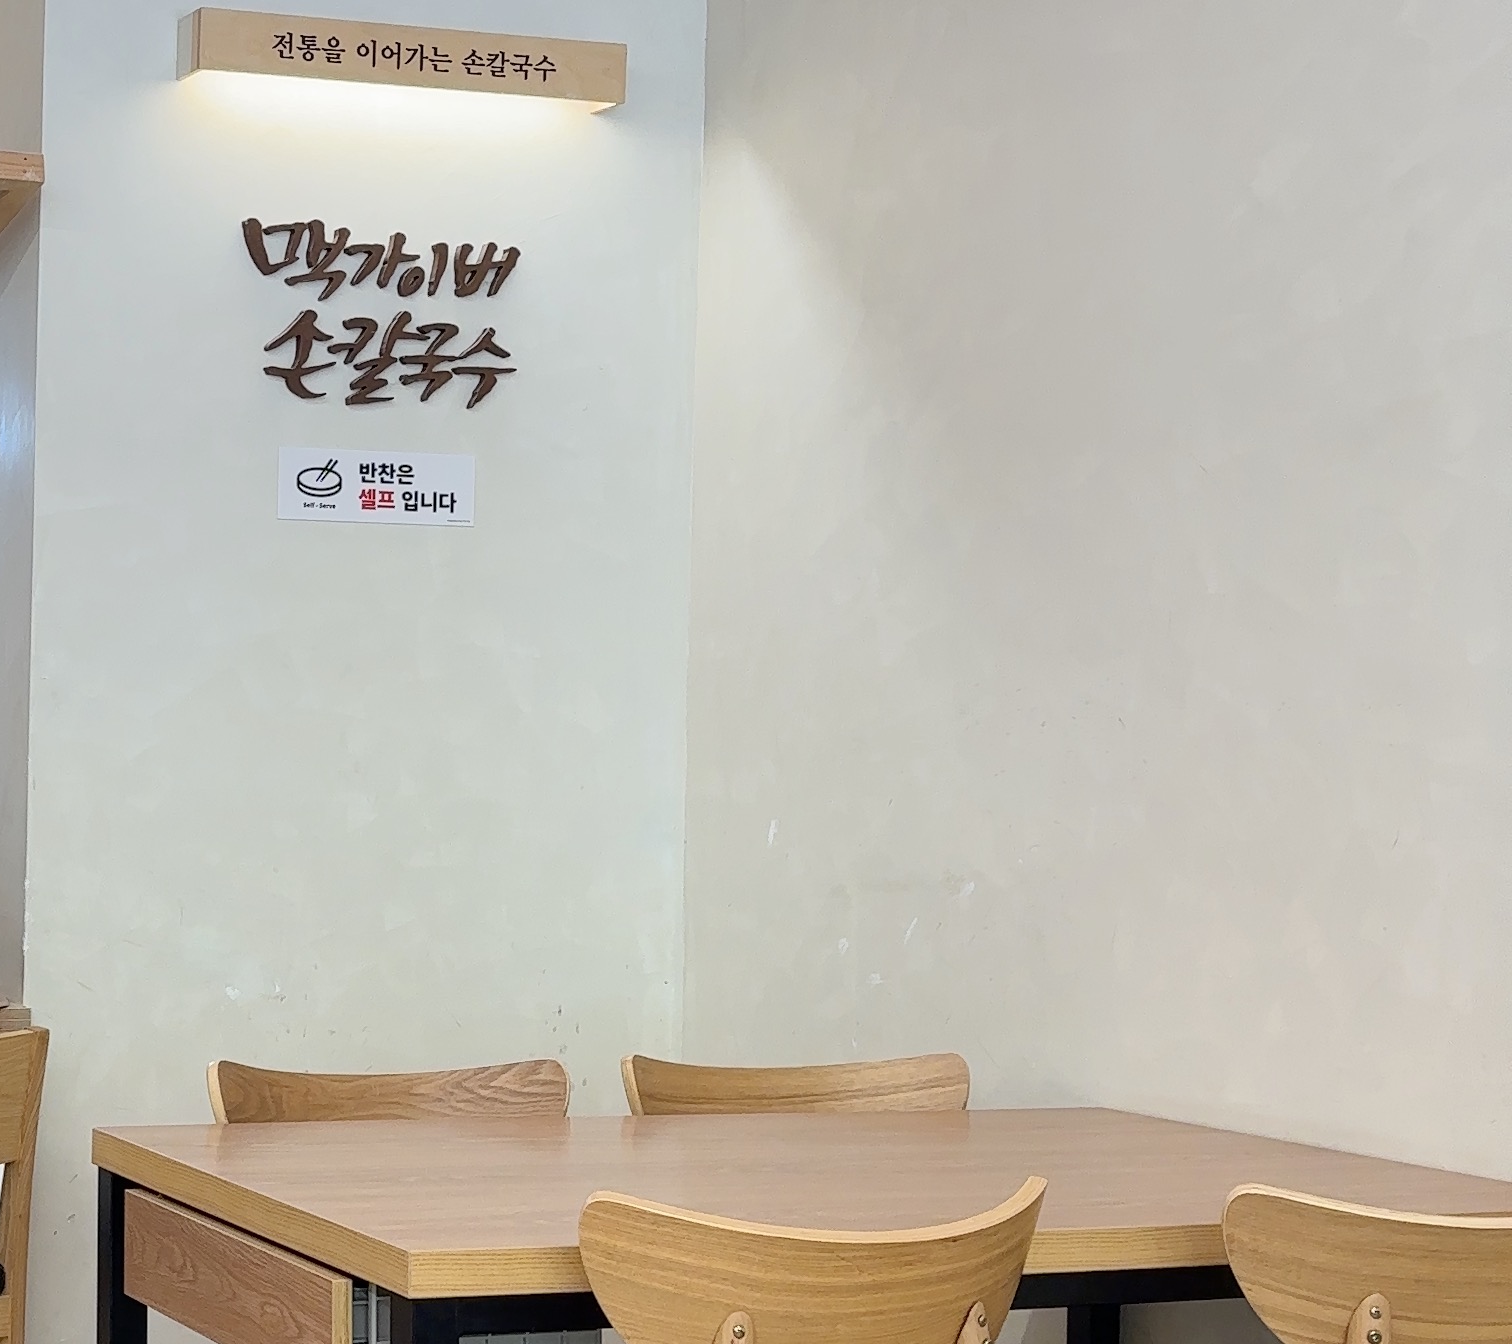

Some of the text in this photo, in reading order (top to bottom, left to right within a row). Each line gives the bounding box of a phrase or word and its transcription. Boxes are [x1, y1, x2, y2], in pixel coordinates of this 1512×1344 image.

[271, 32, 557, 83] 전통을 이어가는 손칼국수
[241, 218, 521, 302] 맥가이버
[263, 309, 518, 409] 손칼국수
[359, 462, 415, 484] 반찬은
[358, 489, 457, 513] 셀프 입니다
